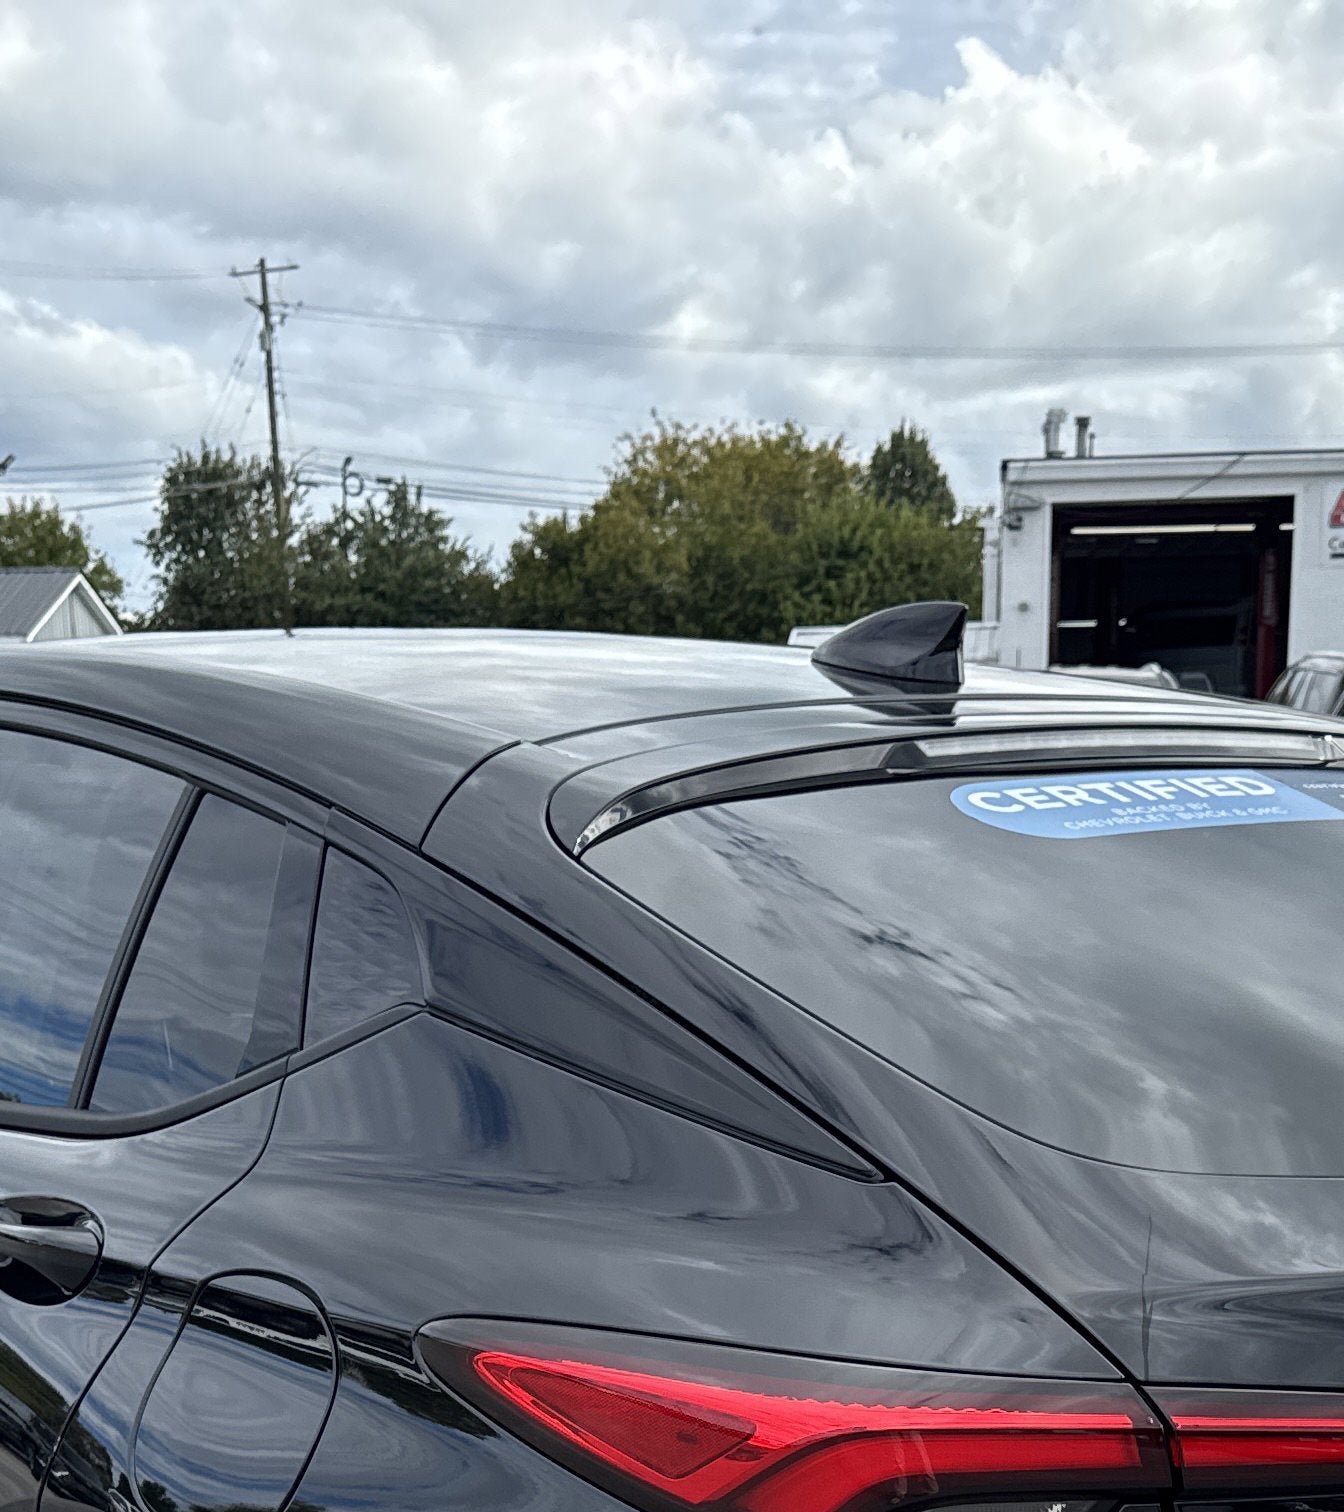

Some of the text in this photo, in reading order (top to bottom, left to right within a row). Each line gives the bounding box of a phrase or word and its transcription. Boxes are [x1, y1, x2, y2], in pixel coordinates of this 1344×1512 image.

[968, 776, 1276, 813] CERTIFIED
[1111, 802, 1211, 817] BACKED BY
[1179, 809, 1230, 821] BUICK
